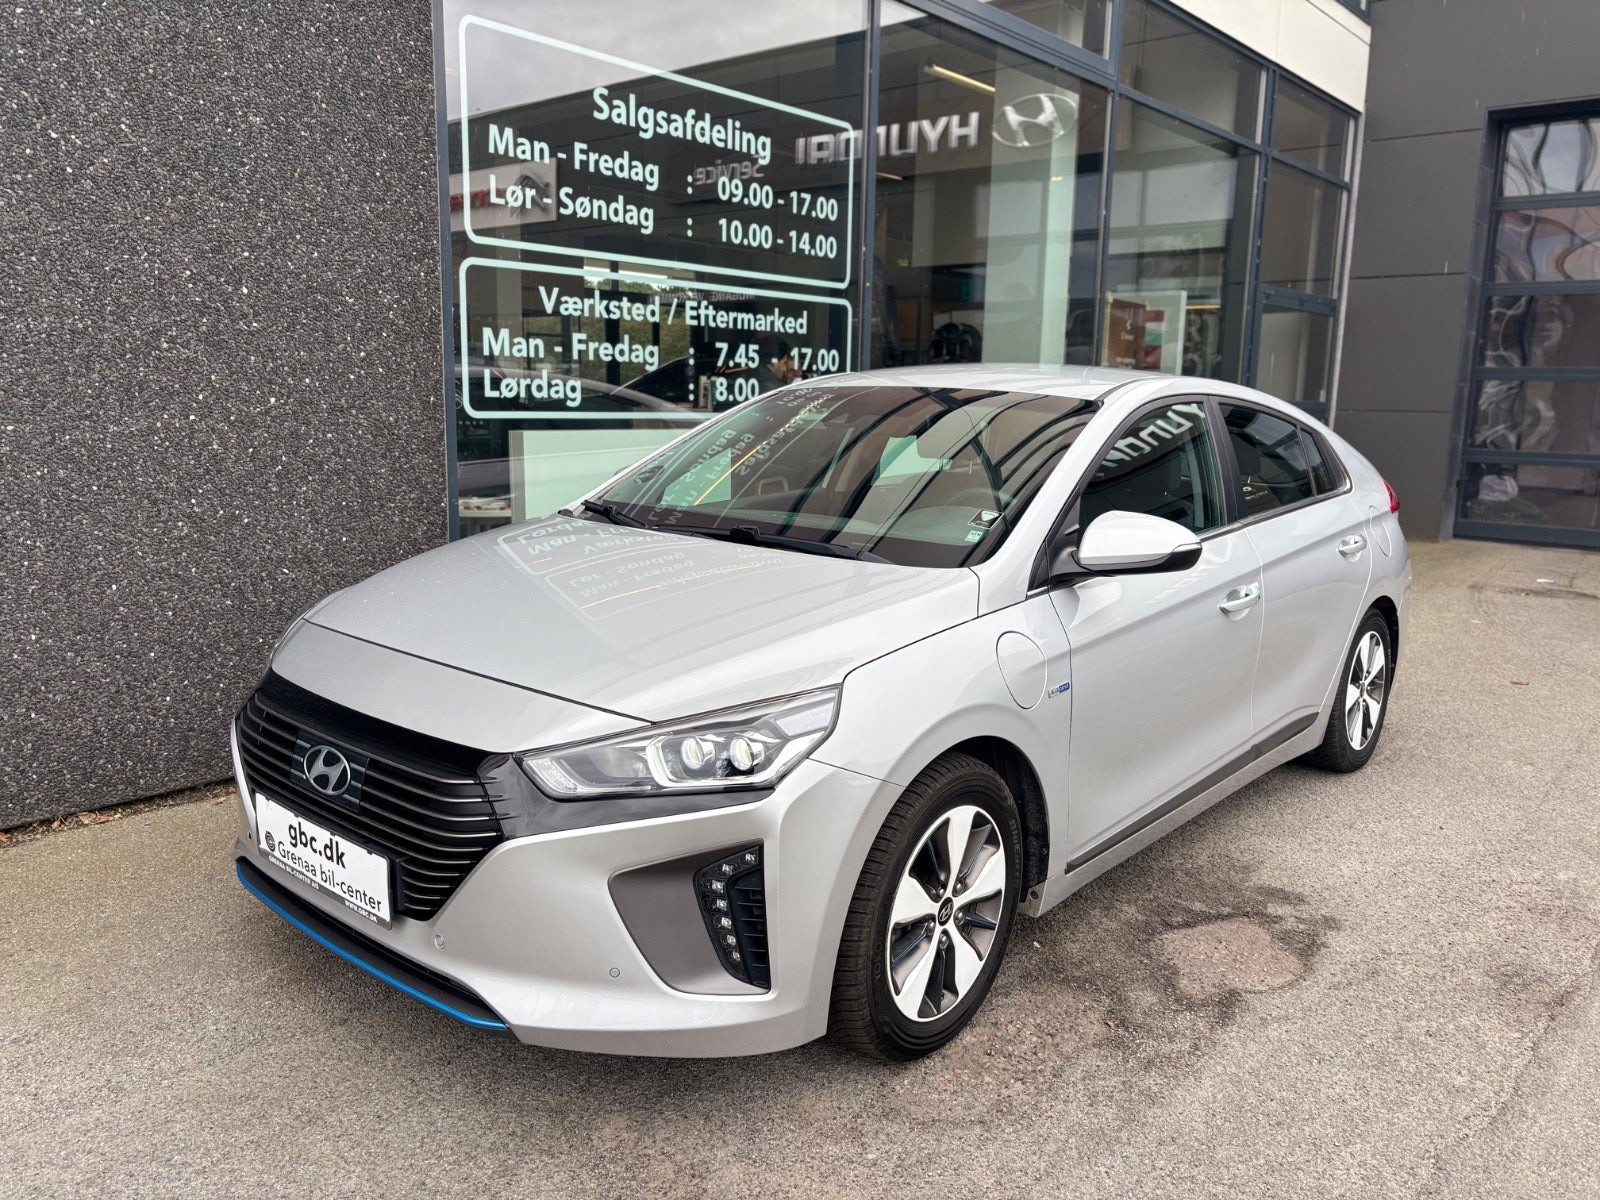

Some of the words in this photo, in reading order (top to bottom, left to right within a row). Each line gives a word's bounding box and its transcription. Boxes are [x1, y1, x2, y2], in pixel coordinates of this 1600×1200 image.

[592, 85, 771, 166] Salgsafdeling
[488, 123, 551, 165] Man
[574, 142, 659, 192] Fredag
[717, 175, 774, 209] 09.00
[790, 191, 838, 221] 17.00
[488, 173, 537, 210] Lør
[559, 186, 654, 235] Søndag
[718, 218, 773, 249] 10.00
[789, 230, 837, 259] 14.00
[538, 285, 660, 323] Værksted
[685, 300, 807, 335] Eftermarked
[482, 326, 545, 358] Man
[572, 332, 659, 372] Fredag
[715, 342, 760, 369] 7.45
[790, 347, 839, 372] 17.00
[483, 368, 582, 408] Lørdag
[715, 377, 759, 402] 8.00
[288, 822, 346, 869] gbc.dk
[277, 841, 317, 877] Grenaa
[320, 863, 382, 912] bil-center
